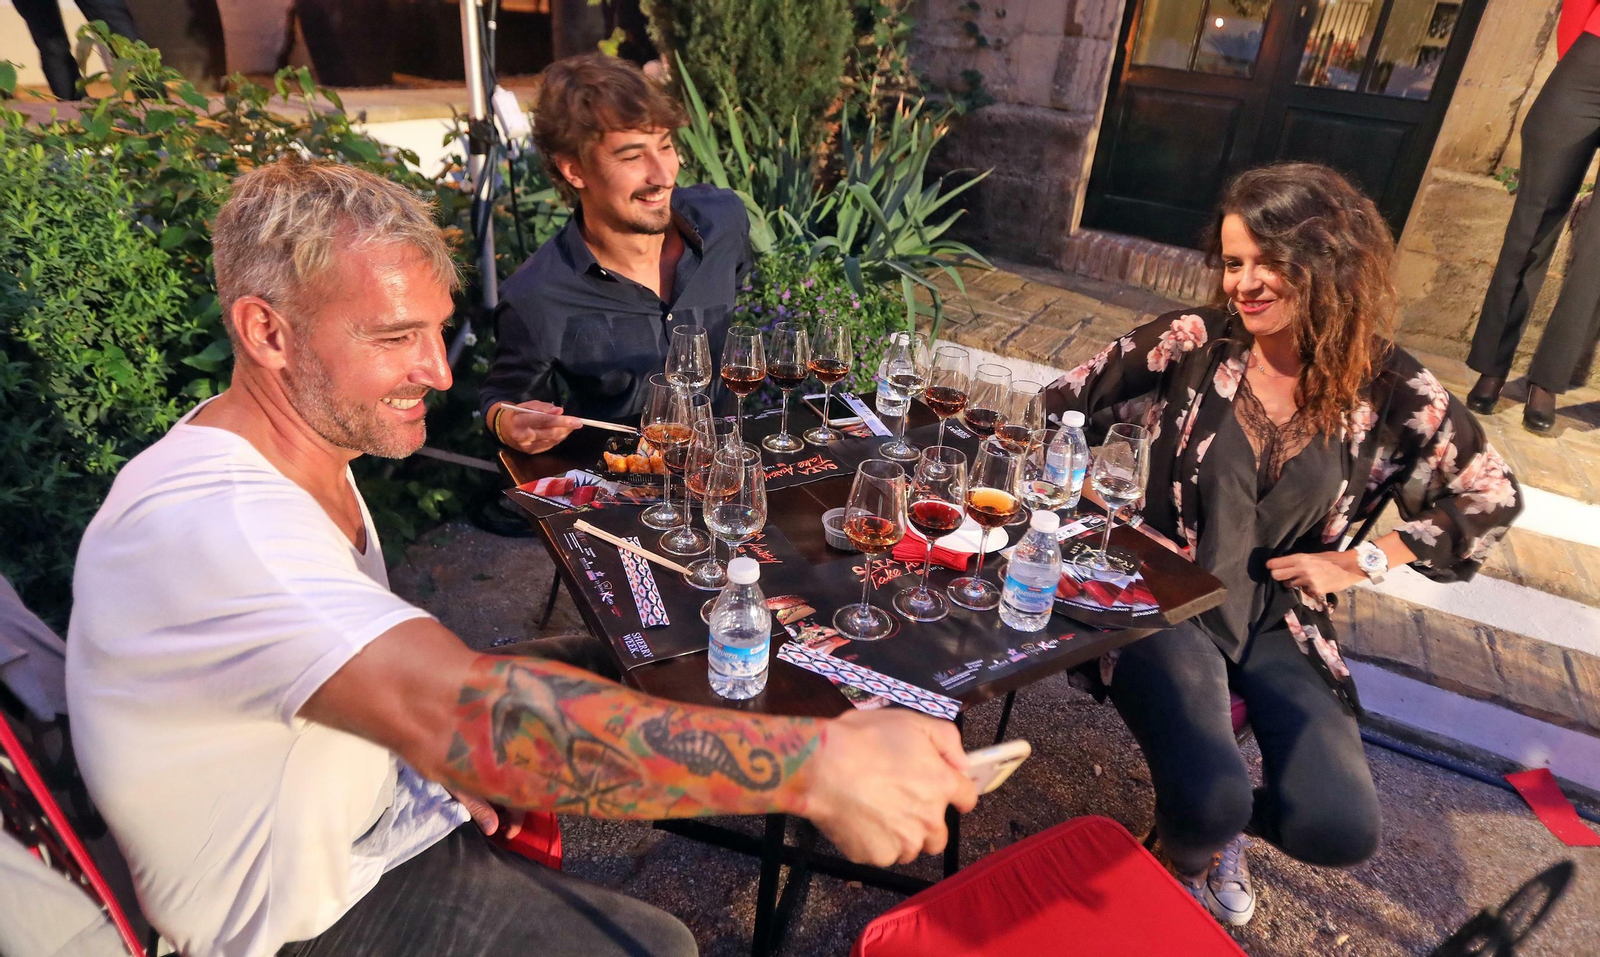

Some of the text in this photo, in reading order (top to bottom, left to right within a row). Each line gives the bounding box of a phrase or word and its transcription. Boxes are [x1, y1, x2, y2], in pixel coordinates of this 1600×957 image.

[797, 454, 832, 468] Take
[622, 633, 640, 654] WEEK
[631, 632, 654, 658] SHERRY
